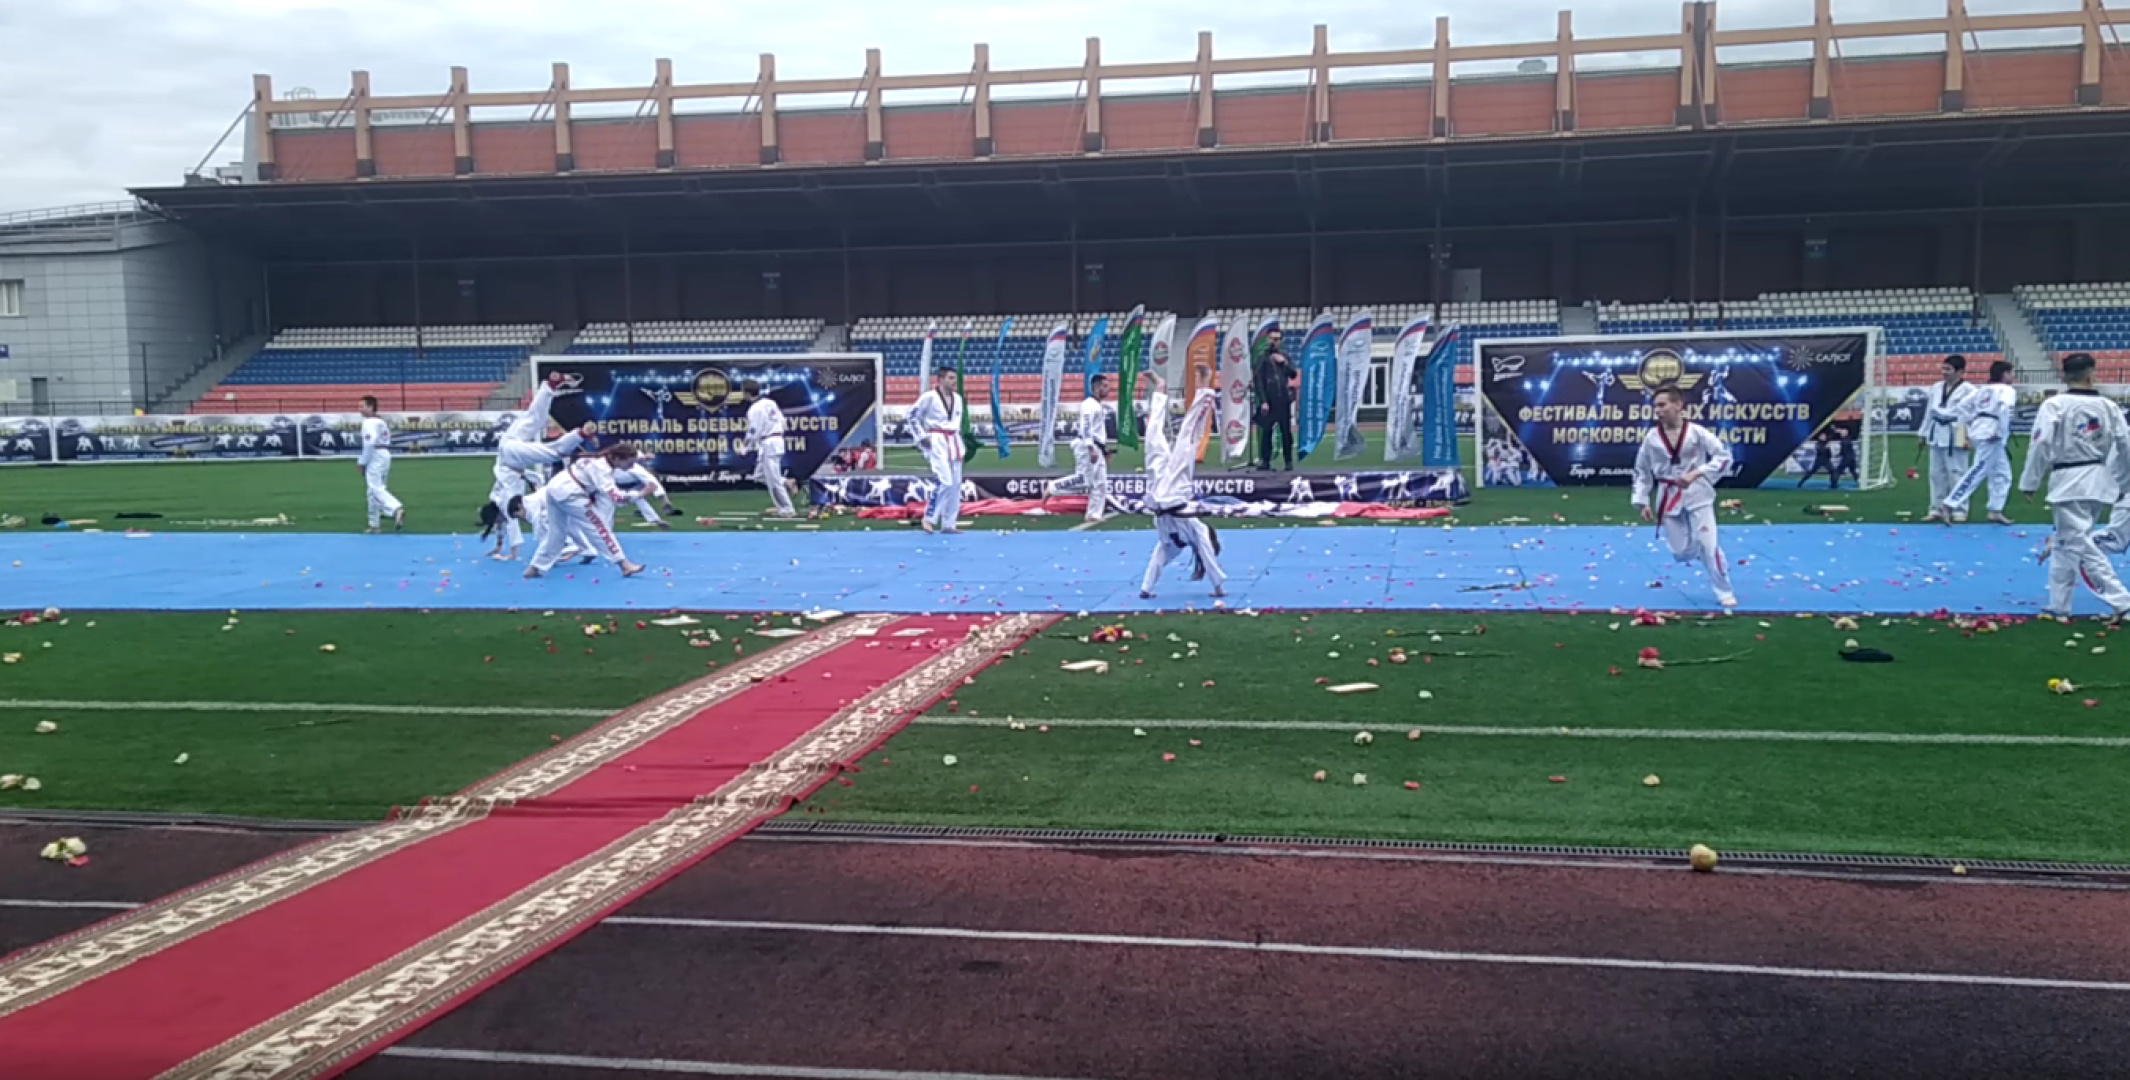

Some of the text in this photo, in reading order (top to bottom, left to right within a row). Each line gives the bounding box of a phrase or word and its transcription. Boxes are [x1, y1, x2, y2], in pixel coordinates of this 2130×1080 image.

[1518, 402, 1810, 422] ФЕСТИВАЛЬ БОЫХ ИСКУССТВ
[785, 416, 839, 431] УССТВ
[620, 434, 728, 453] ОСКОВСКОЙ
[1552, 426, 1648, 444] МОСКОВСК
[1106, 478, 1255, 494] БОЕВ КУССТВ
